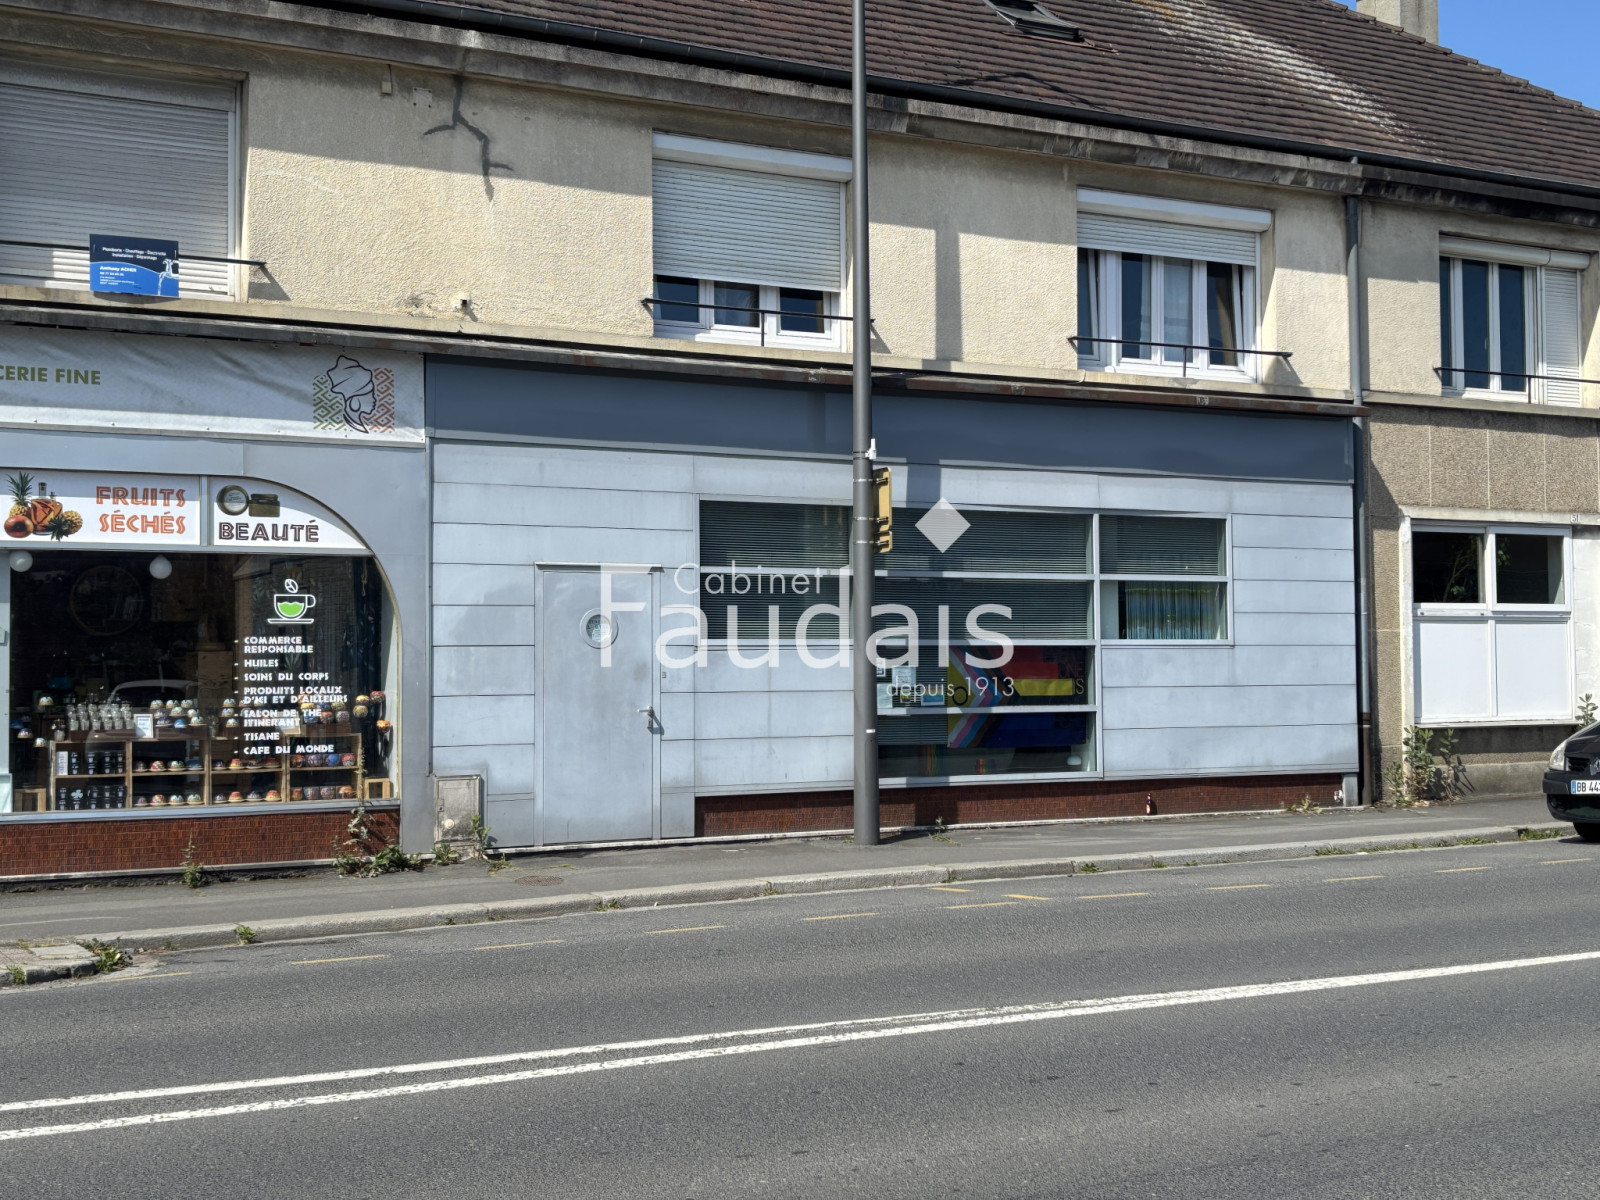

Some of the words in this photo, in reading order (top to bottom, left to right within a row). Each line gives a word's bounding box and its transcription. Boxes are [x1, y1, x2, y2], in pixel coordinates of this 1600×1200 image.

[56, 368, 101, 385] FINE
[95, 486, 186, 507] FRUITS
[99, 510, 186, 534] SÉCHÉS
[218, 520, 320, 542] BEAUTÉ
[244, 636, 302, 645] COMMERCE
[244, 645, 314, 654] RESPONSABLE
[244, 659, 279, 667] HUILES
[244, 672, 273, 681] SOINS
[278, 673, 293, 681] DU
[298, 672, 329, 681] CORPS
[243, 687, 295, 695] PRODUITS
[300, 686, 342, 694] LOCAUX
[244, 695, 268, 704] D'ICI
[272, 695, 286, 704] ET
[290, 694, 348, 703] D'AILLEURS
[244, 709, 278, 718] SALON
[283, 709, 297, 717] DE
[302, 708, 322, 717] THE
[244, 718, 300, 727] ITINERANT
[244, 732, 280, 741] TISANE
[243, 746, 270, 755] CAFE
[275, 745, 291, 754] DU
[296, 744, 335, 753] MONDE
[1589, 781, 1600, 792] 44
